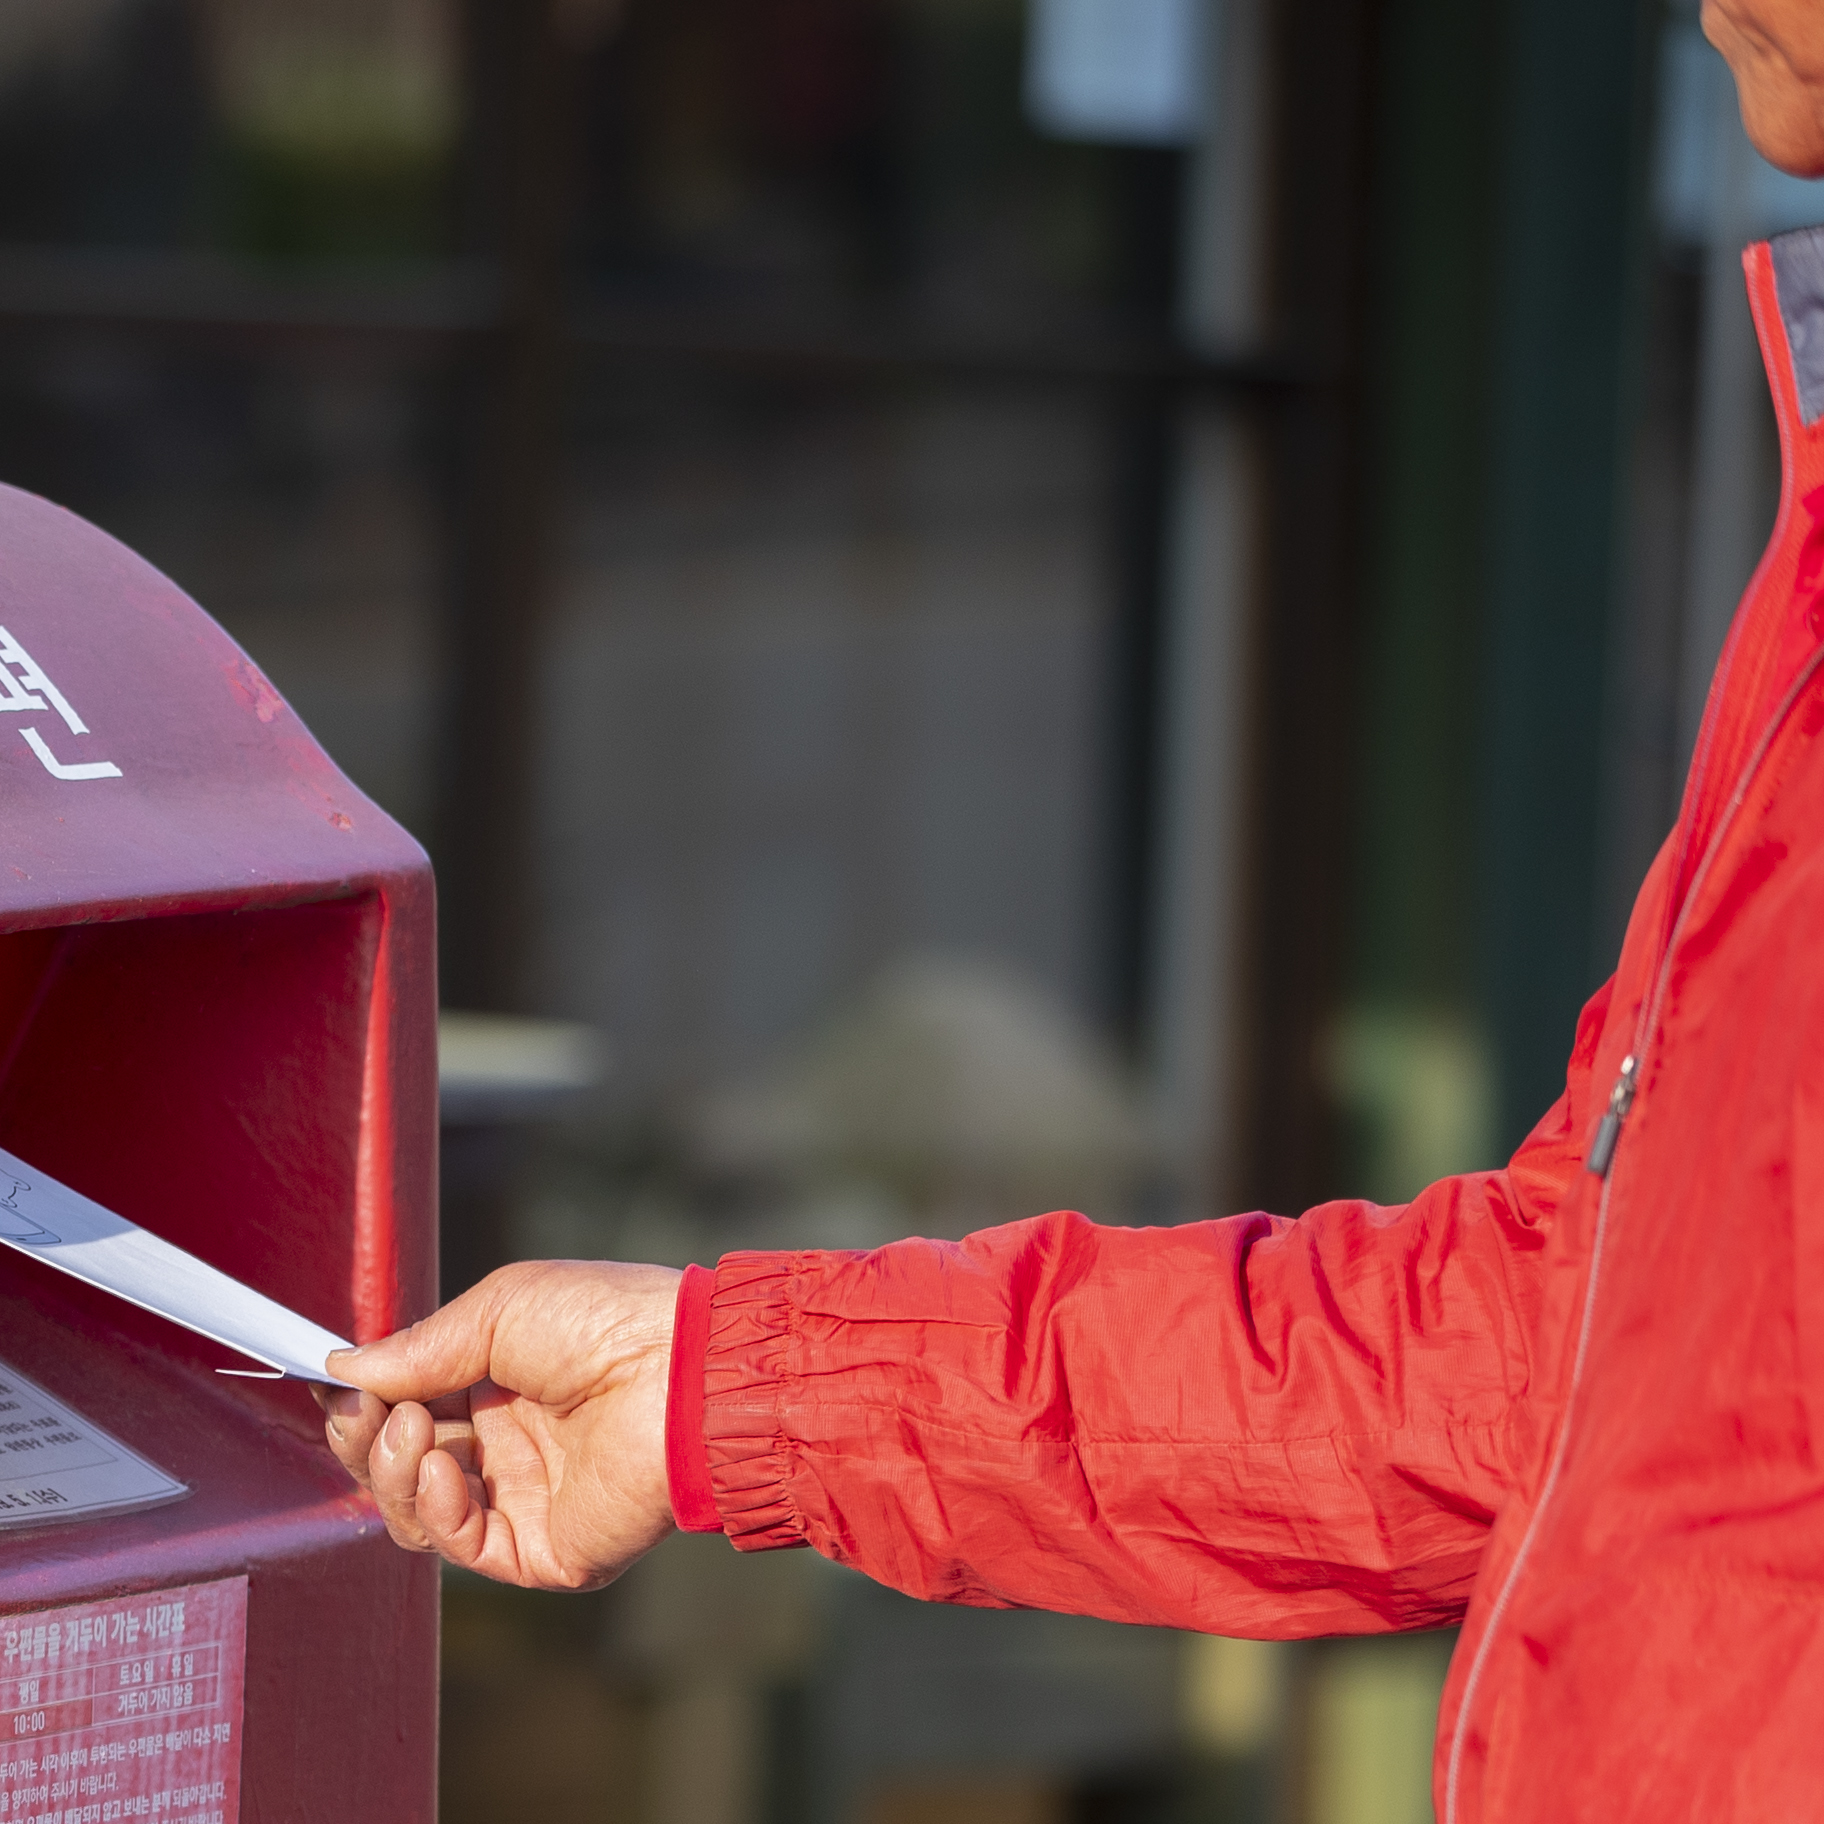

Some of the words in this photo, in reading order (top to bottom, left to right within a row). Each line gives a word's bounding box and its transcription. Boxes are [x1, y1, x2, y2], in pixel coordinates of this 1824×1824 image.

[5, 1493, 30, 1506] 5.
[4, 1623, 60, 1662] 우편물을
[65, 1615, 106, 1654] 거두어
[111, 1610, 140, 1644] 가는
[143, 1601, 185, 1638] 시간표
[119, 1659, 153, 1685] 토요일
[171, 1653, 193, 1677] 휴일
[18, 1679, 39, 1705] 평일
[117, 1690, 148, 1715] 거두어
[150, 1686, 170, 1710] 가지
[172, 1682, 193, 1707] 않음
[13, 1710, 45, 1734] 10:00
[19, 1757, 37, 1779] 가는
[40, 1753, 59, 1775] 시각
[59, 1748, 87, 1773] 이후에
[90, 1742, 126, 1764] 투함되는
[128, 1733, 163, 1757] 우편물은
[165, 1729, 191, 1751] 배달이
[192, 1724, 210, 1746] 다소
[212, 1722, 230, 1744] 지연
[11, 1783, 48, 1810] 양지하여
[50, 1778, 78, 1801] 주시기
[80, 1772, 119, 1795] 바랍니다.
[102, 1799, 120, 1821] 않고
[123, 1795, 149, 1816] 보내는
[173, 1781, 227, 1806] 되돌아갑니다.
